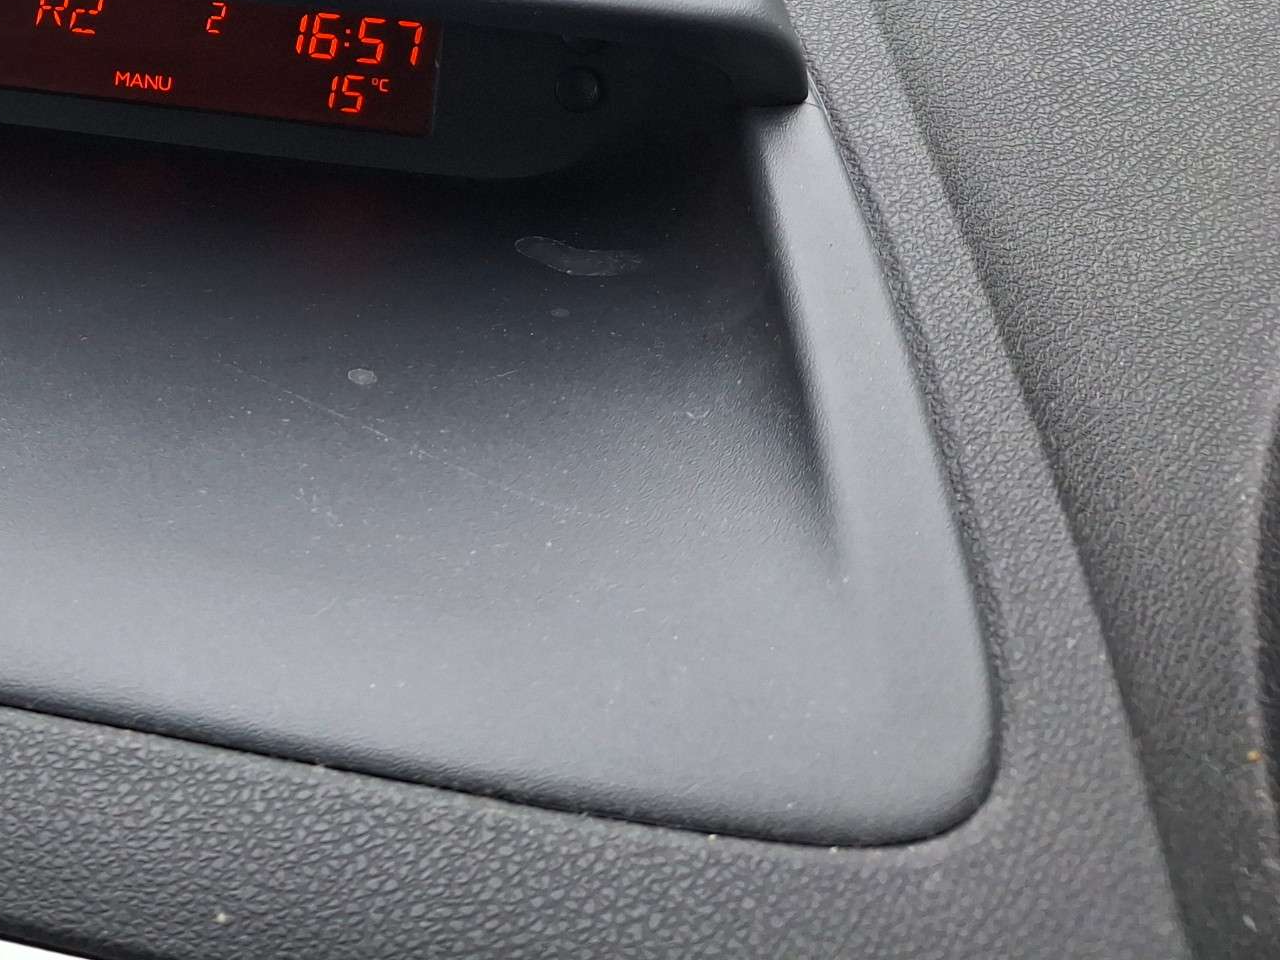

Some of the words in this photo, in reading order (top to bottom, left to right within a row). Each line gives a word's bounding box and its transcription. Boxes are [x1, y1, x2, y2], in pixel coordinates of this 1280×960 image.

[206, 1, 227, 35] 2
[295, 12, 424, 67] 16:57
[114, 70, 174, 93] MANU
